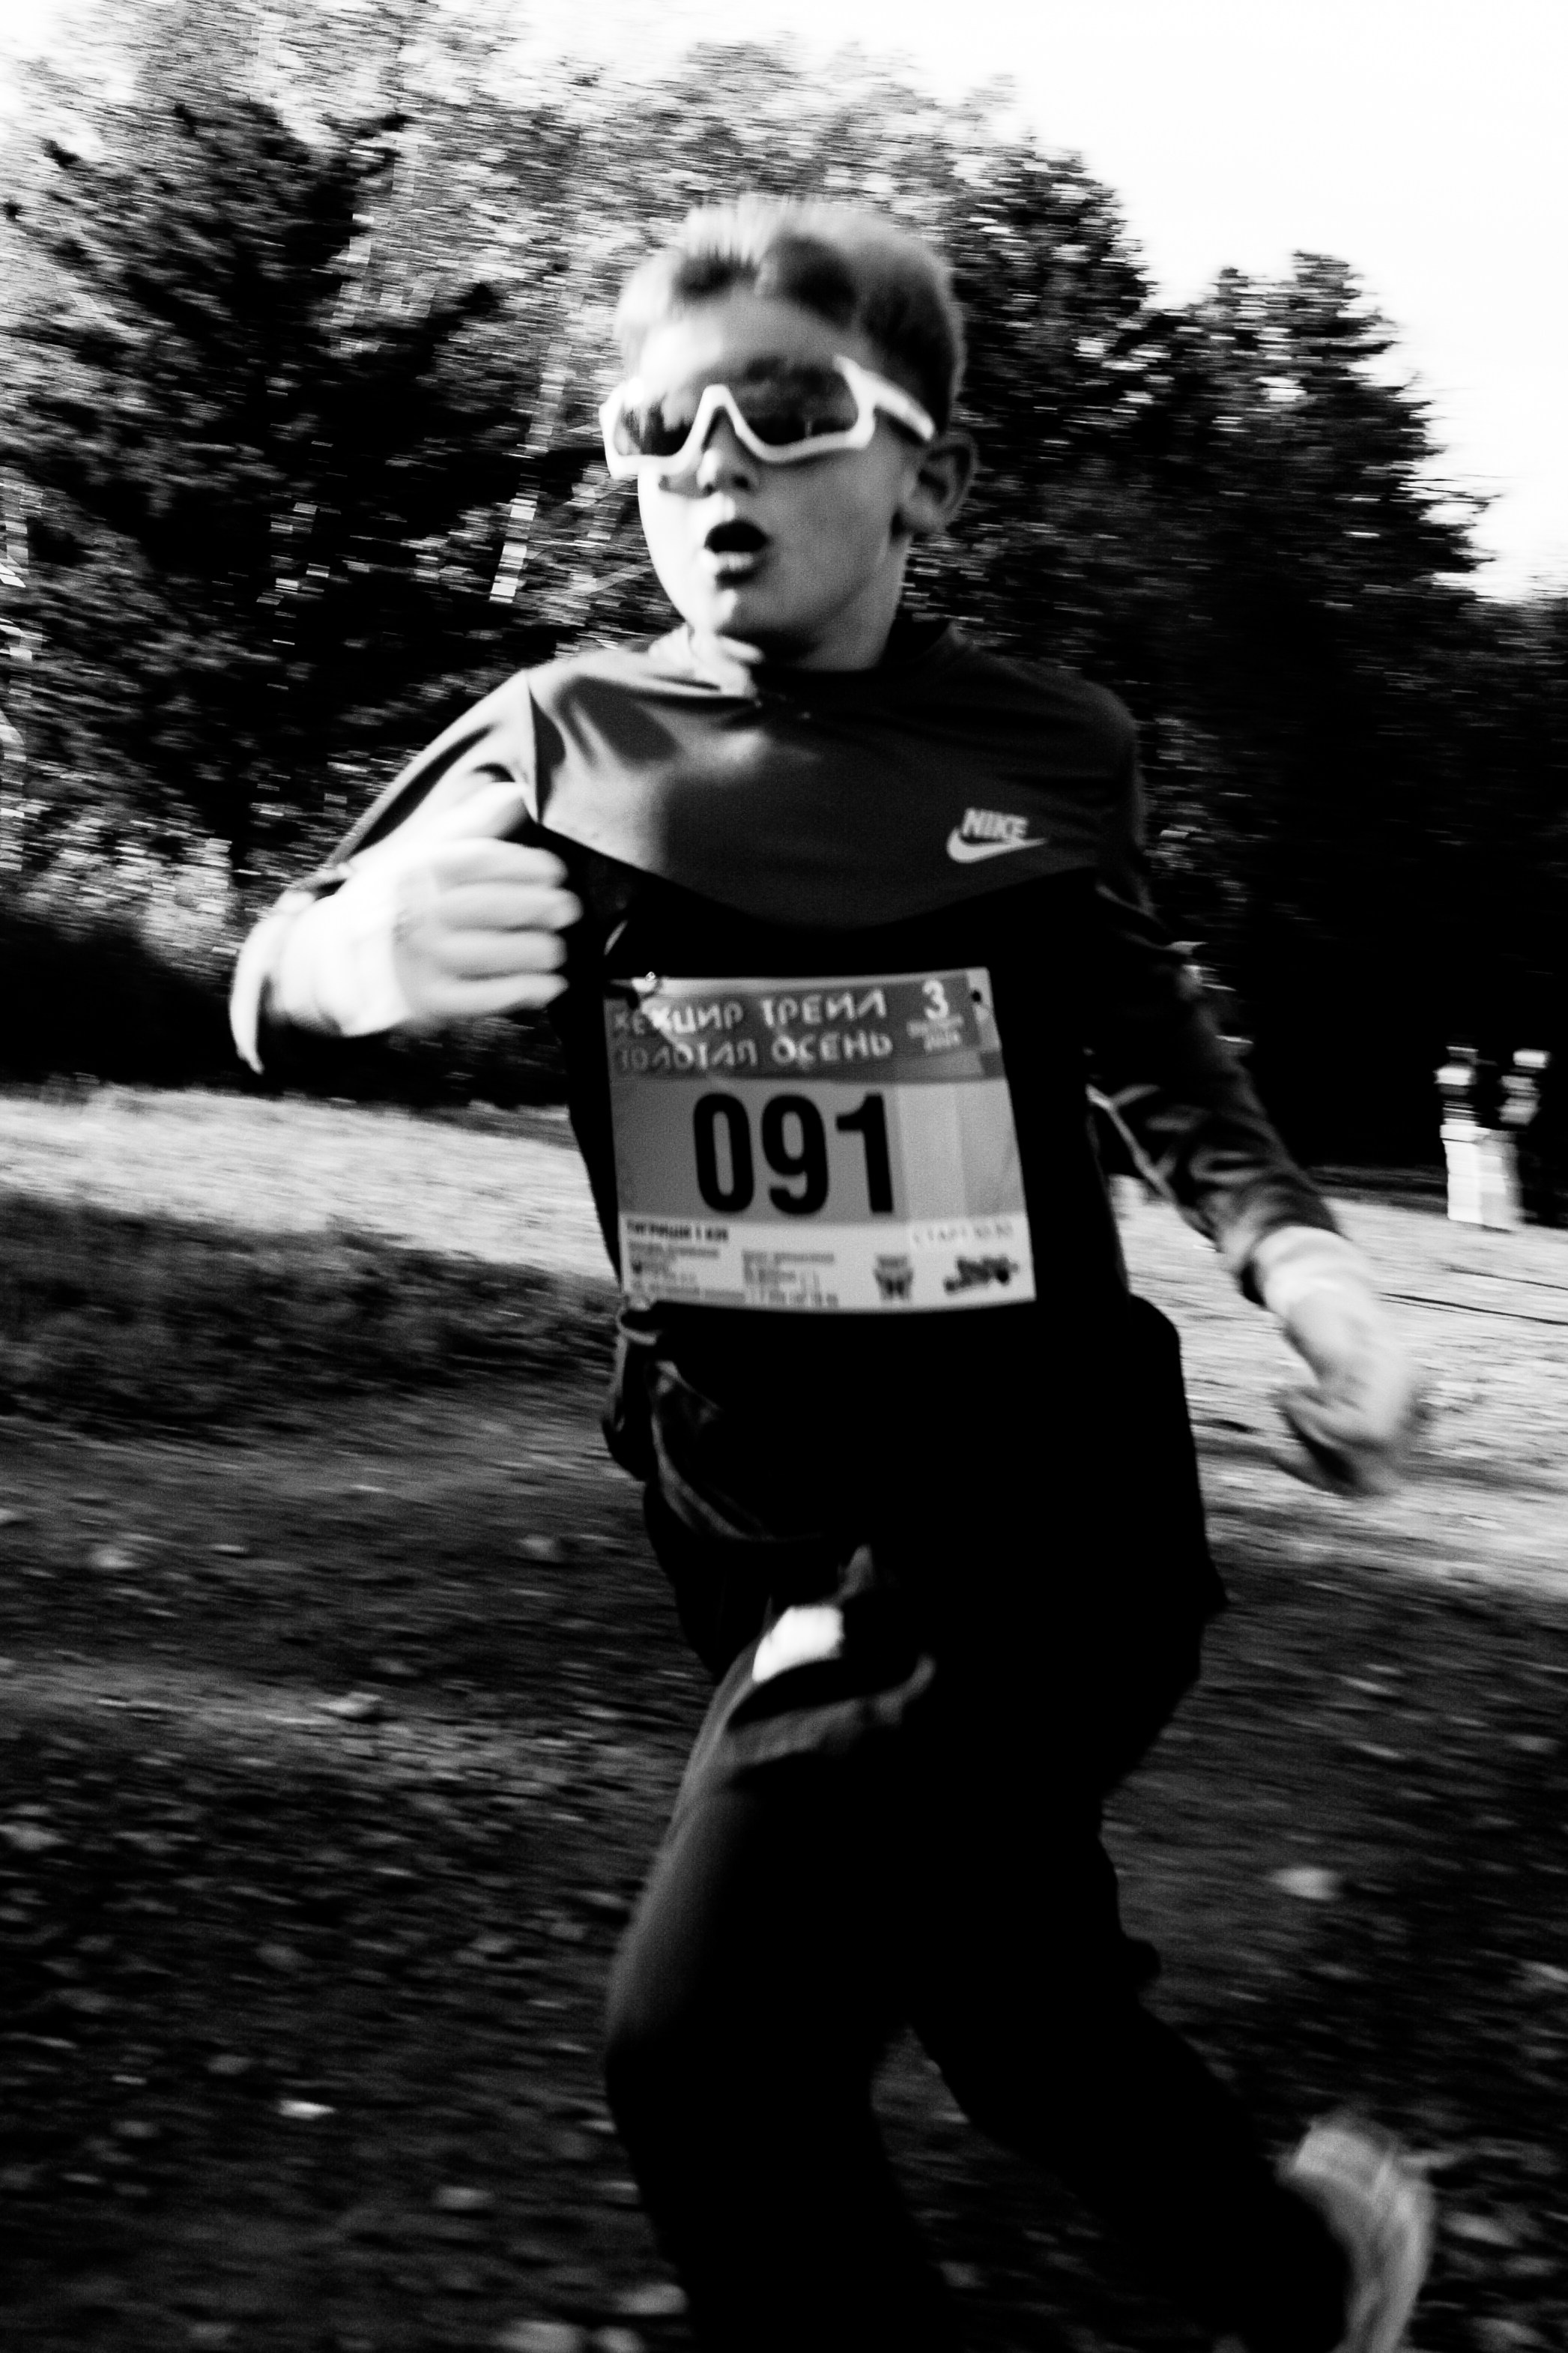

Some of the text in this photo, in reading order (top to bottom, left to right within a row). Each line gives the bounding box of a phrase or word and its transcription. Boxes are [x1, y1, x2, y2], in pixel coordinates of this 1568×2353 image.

[961, 807, 1029, 839] NIKE
[921, 979, 948, 1020] 3
[771, 1030, 893, 1068] ОСЕНЬ
[692, 1091, 895, 1215] 091
